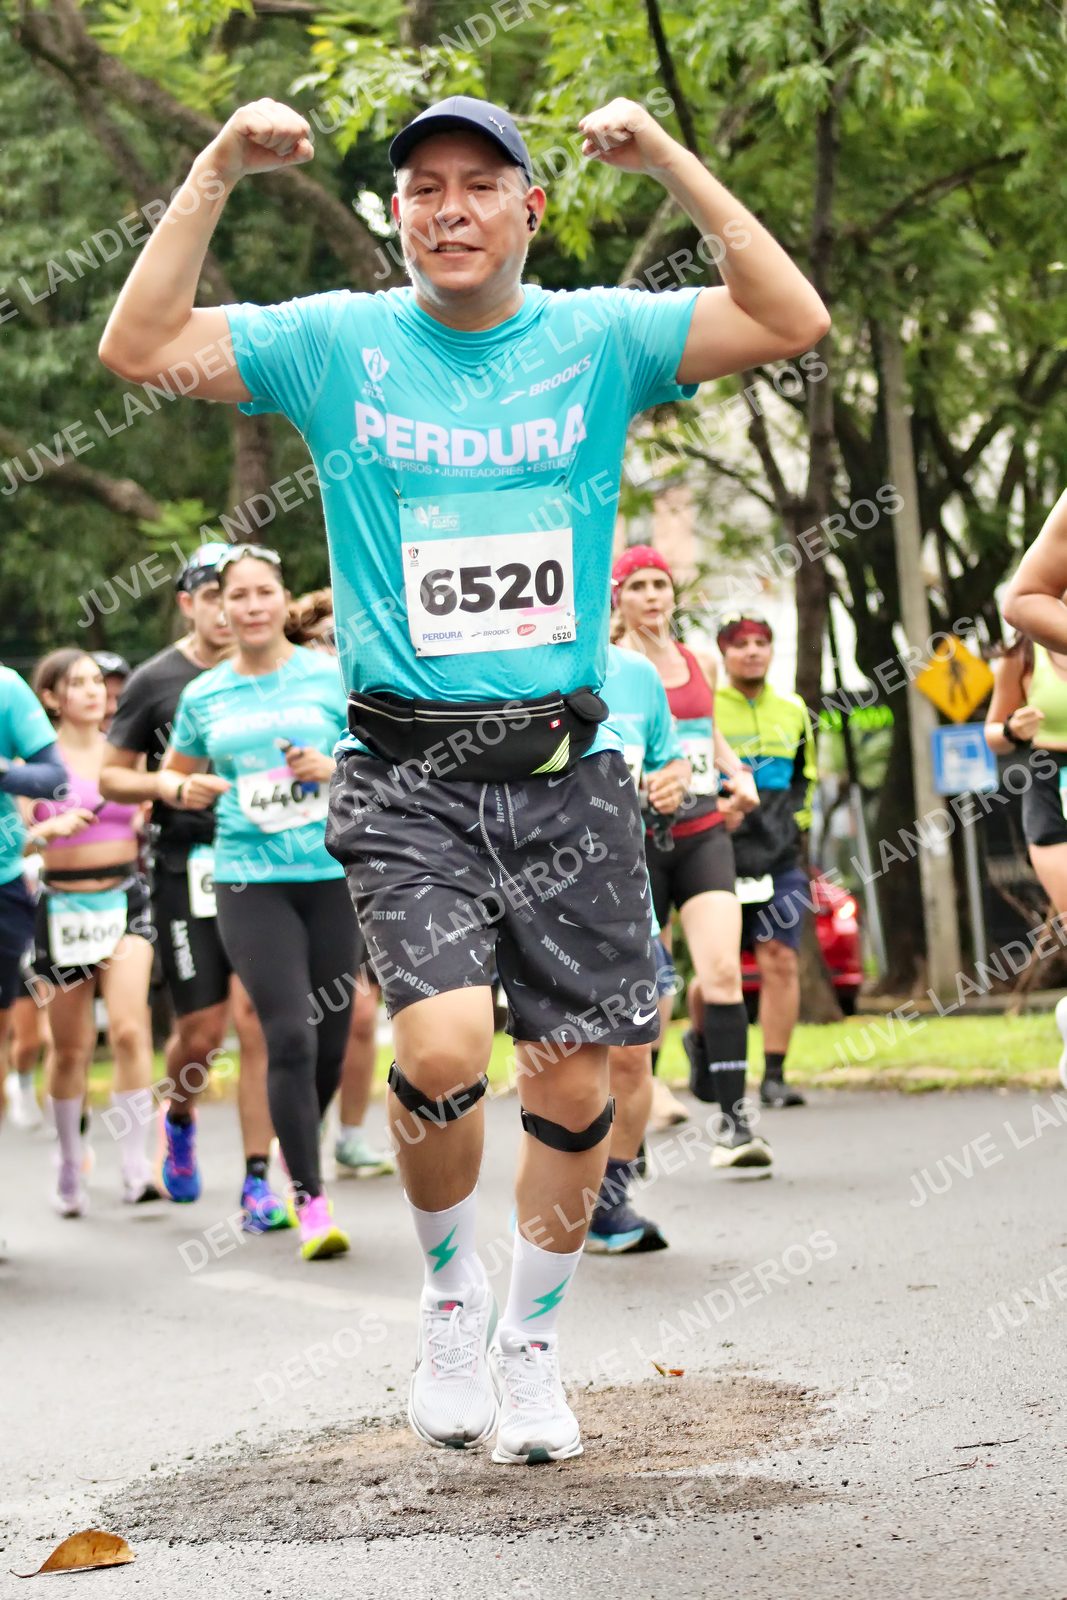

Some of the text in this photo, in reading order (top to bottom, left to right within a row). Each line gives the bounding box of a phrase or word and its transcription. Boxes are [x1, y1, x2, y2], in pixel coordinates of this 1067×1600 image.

[528, 353, 592, 397] BROOKS
[354, 400, 588, 467] PERDURA
[400, 462, 432, 475] PISOS
[441, 466, 524, 478] JUNTEADORES
[419, 559, 564, 616] 6520
[422, 631, 463, 641] PERDURA
[483, 628, 512, 637] BROOKS
[552, 631, 572, 641] 6520
[590, 796, 605, 810] JUST
[604, 802, 613, 813] DO
[528, 831, 537, 842] DO
[539, 887, 558, 903] JUST
[557, 879, 568, 892] DO
[372, 911, 385, 920] JUST
[386, 911, 397, 920] DO
[541, 935, 560, 956] JUST
[558, 948, 571, 966] DO
